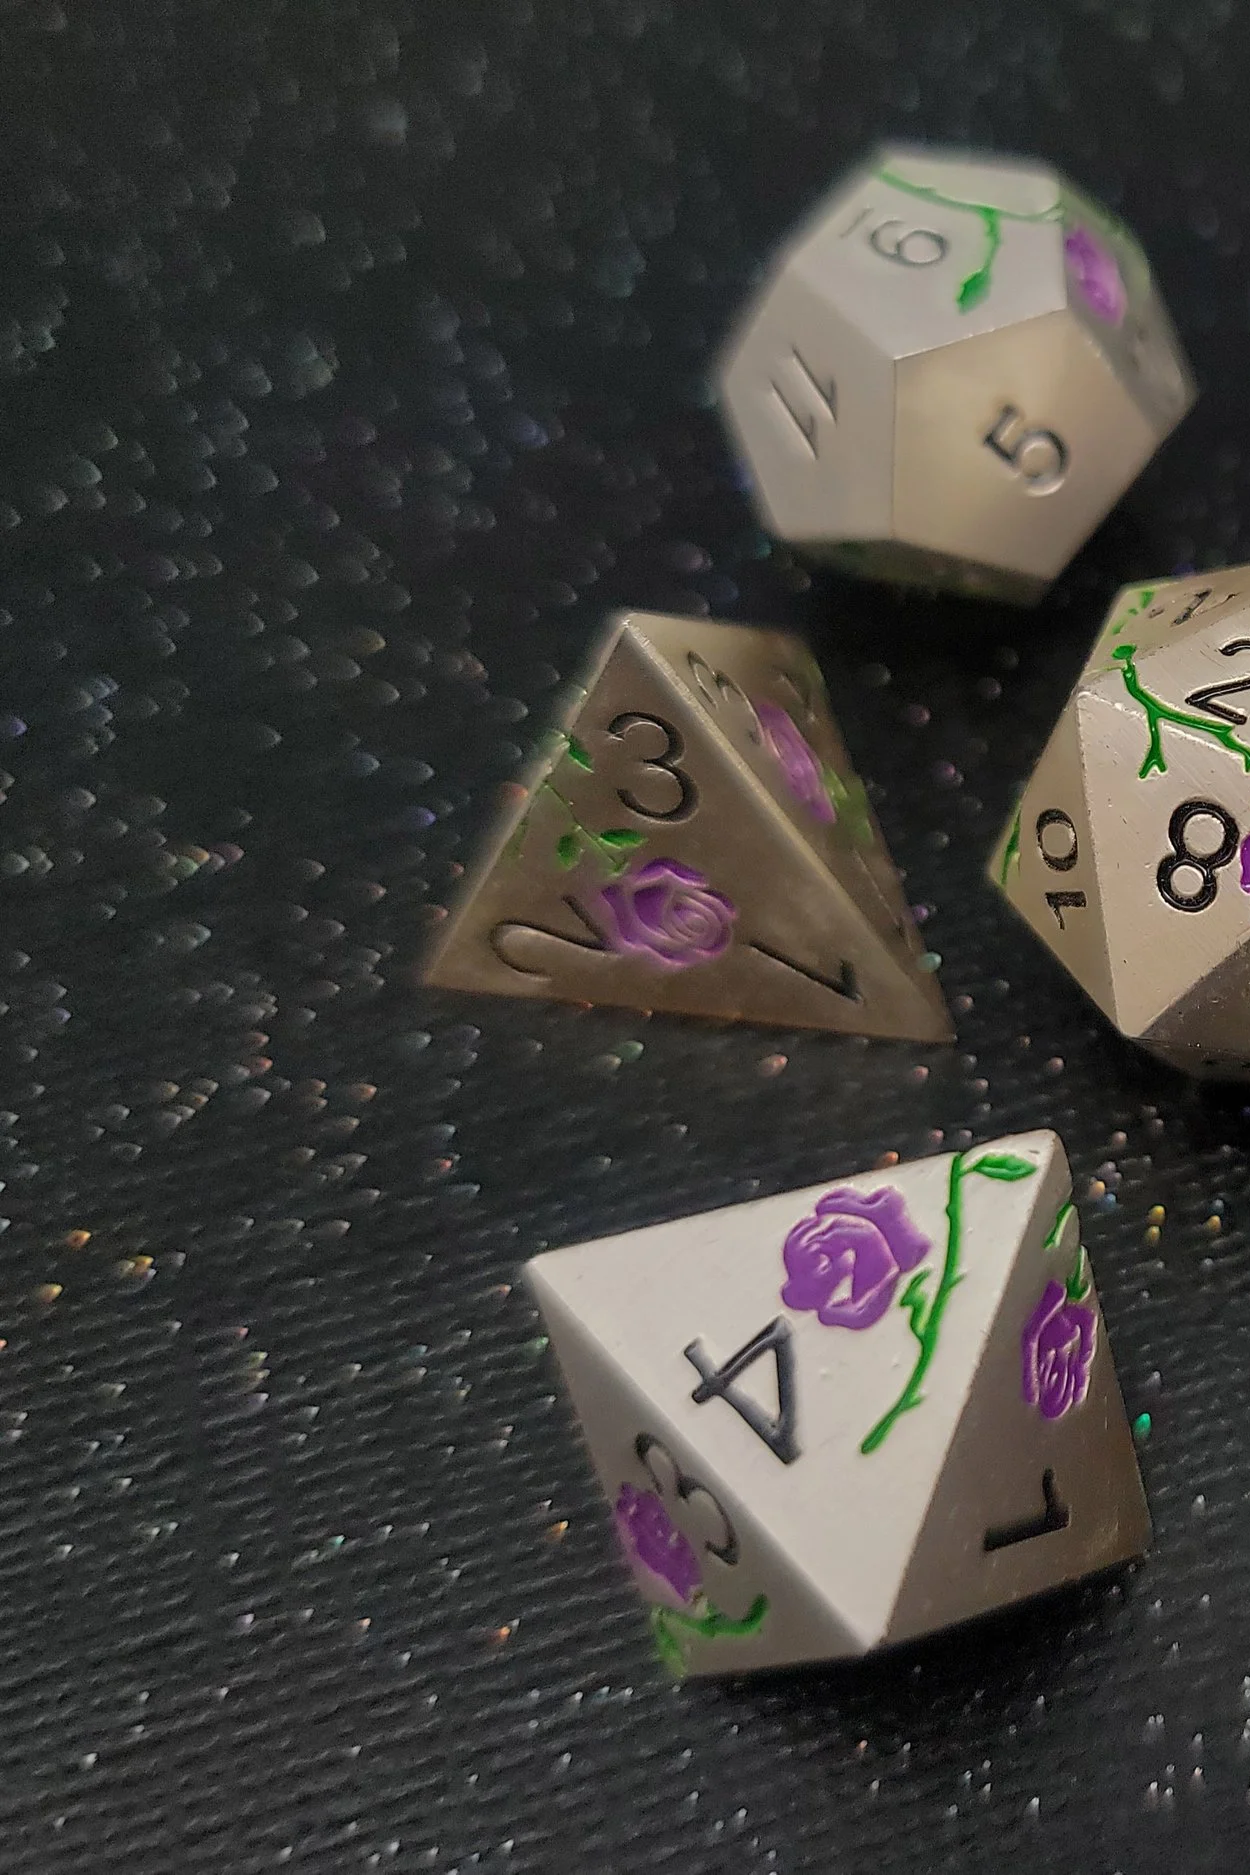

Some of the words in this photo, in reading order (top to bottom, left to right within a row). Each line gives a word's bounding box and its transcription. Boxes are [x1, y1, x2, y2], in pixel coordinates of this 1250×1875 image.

[980, 402, 1072, 498] 5
[606, 711, 700, 824] 3
[1034, 807, 1087, 930] 10
[1155, 798, 1240, 914] 8
[490, 894, 622, 982] 2
[682, 1314, 800, 1467] 4
[634, 1431, 738, 1567] 3
